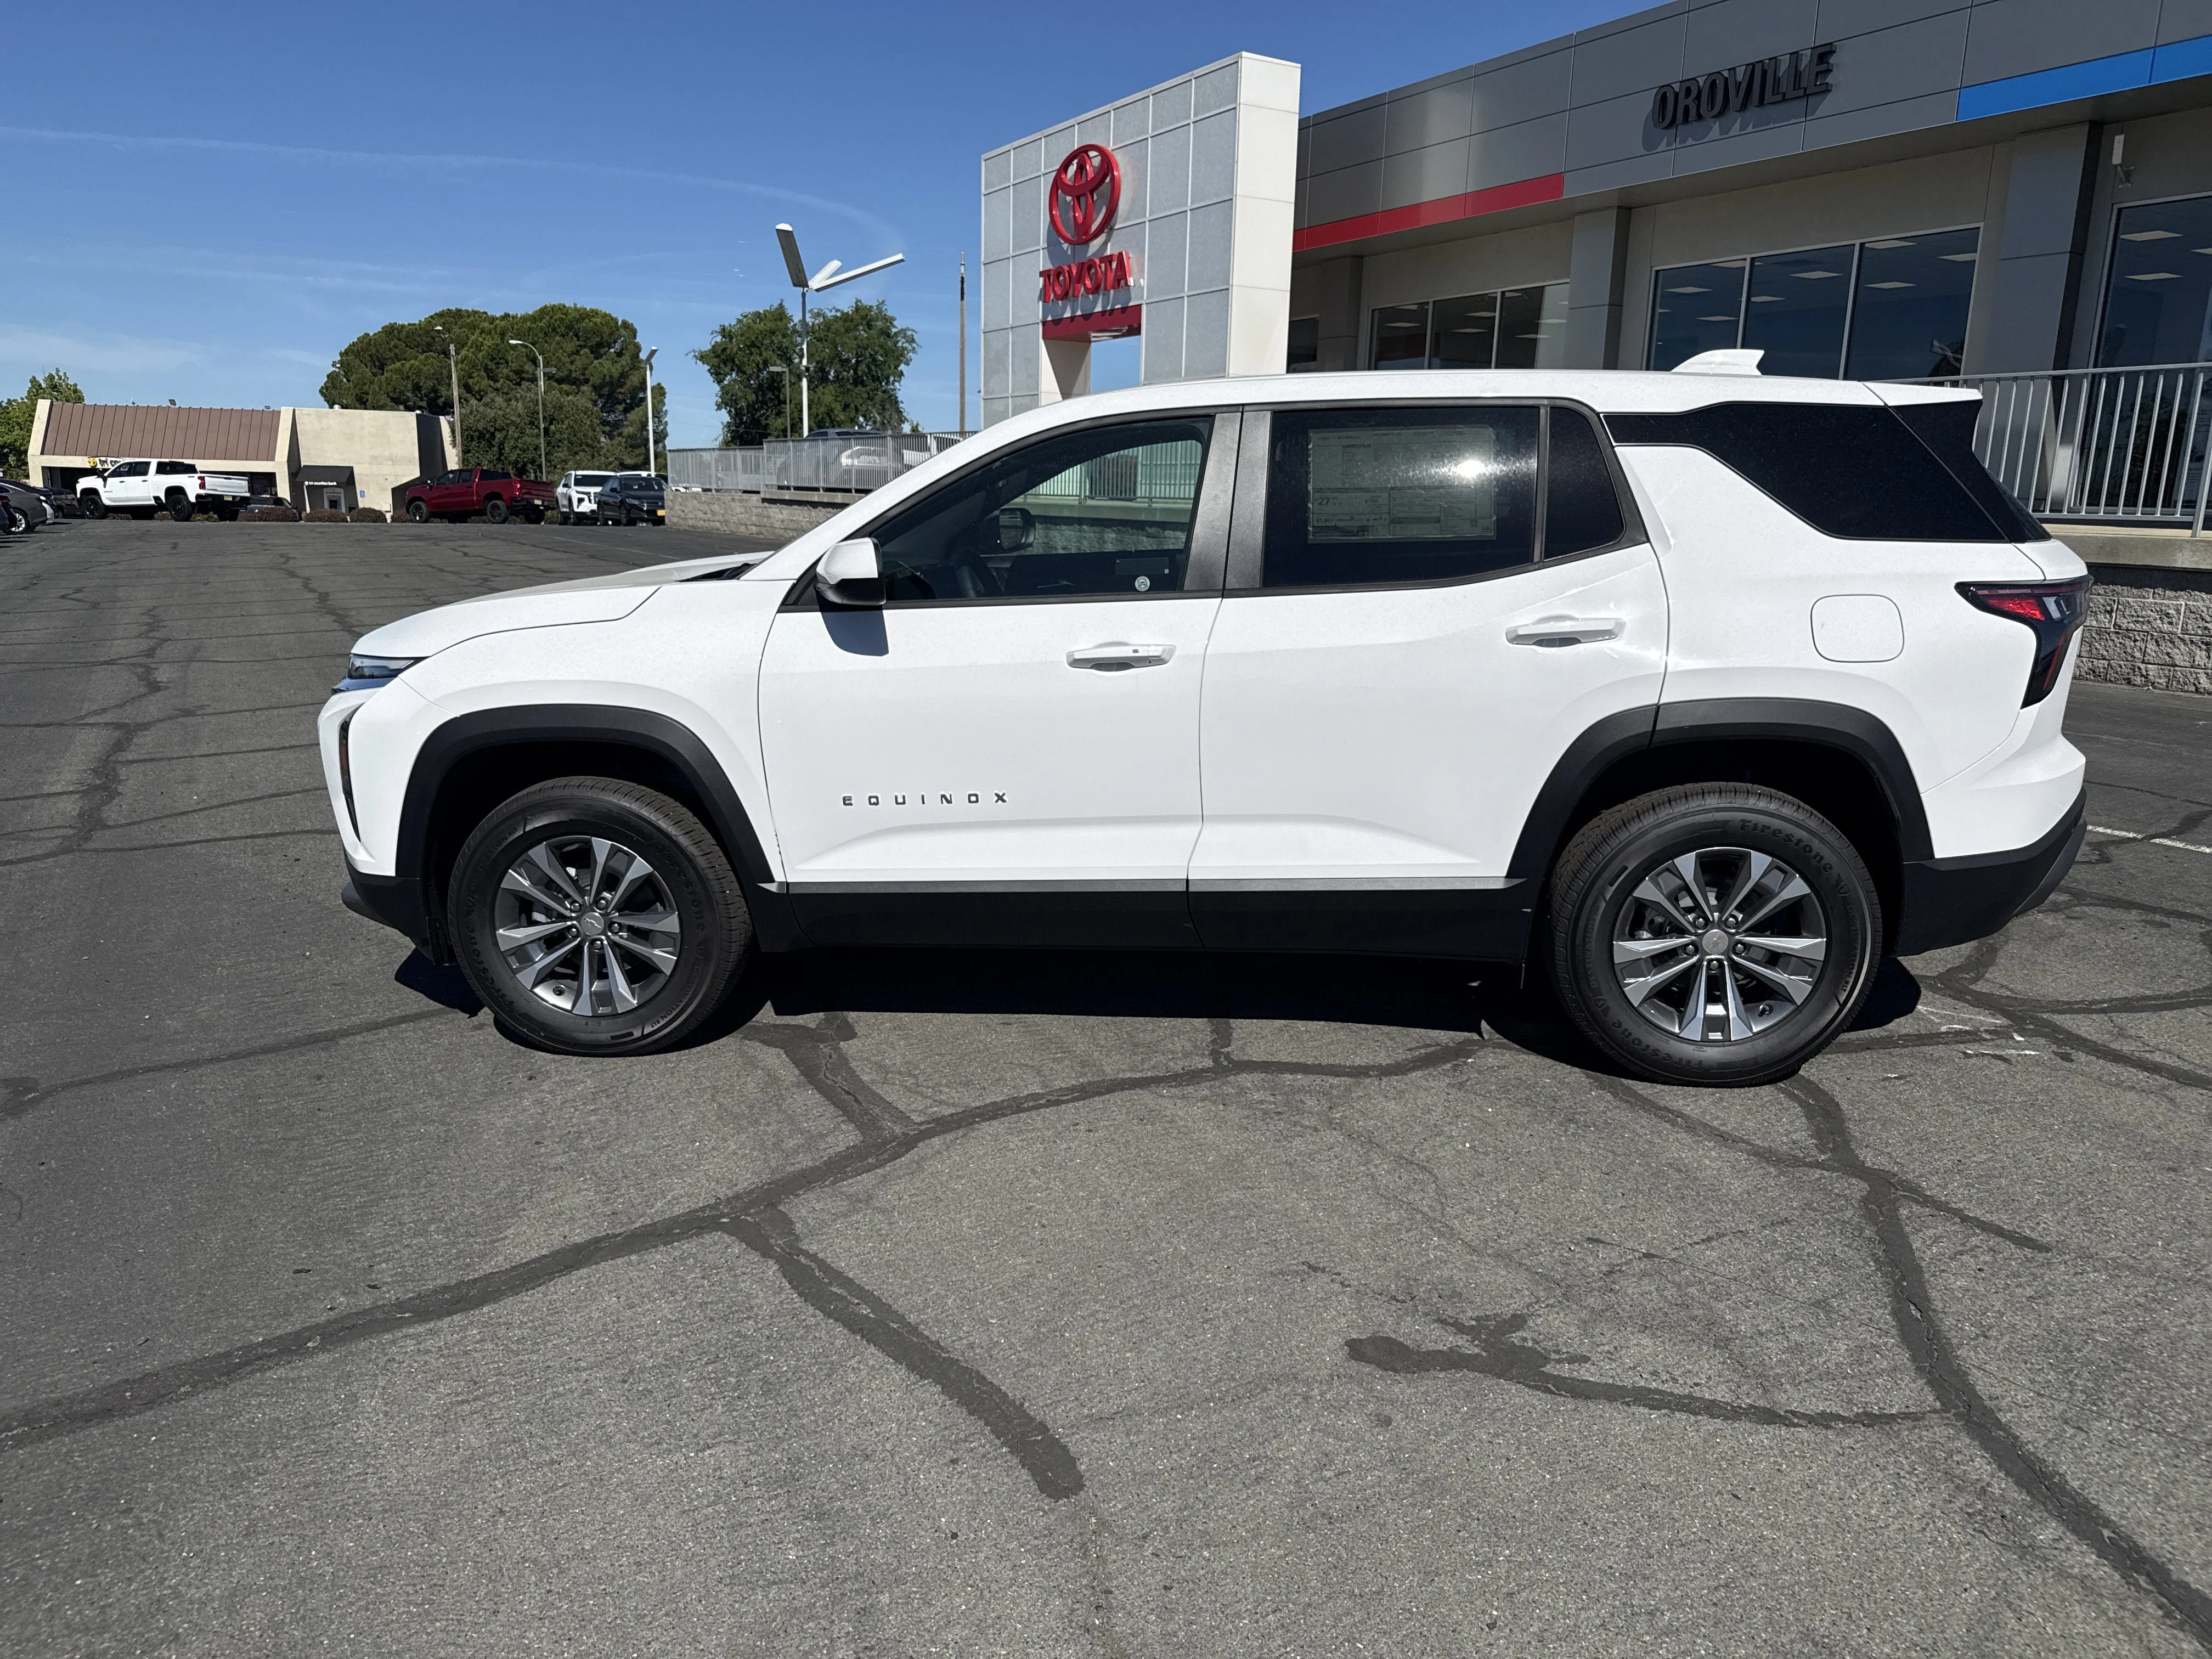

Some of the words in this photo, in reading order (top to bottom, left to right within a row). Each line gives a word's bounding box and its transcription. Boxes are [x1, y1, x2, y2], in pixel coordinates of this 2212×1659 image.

[1652, 43, 1837, 129] OROVILLE
[1039, 251, 1133, 303] TOYOTA
[842, 793, 1007, 806] EQUINOX
[1737, 818, 1833, 873] Firestone
[467, 924, 515, 1008] Firestone
[1611, 1019, 1703, 1071] Firestone
